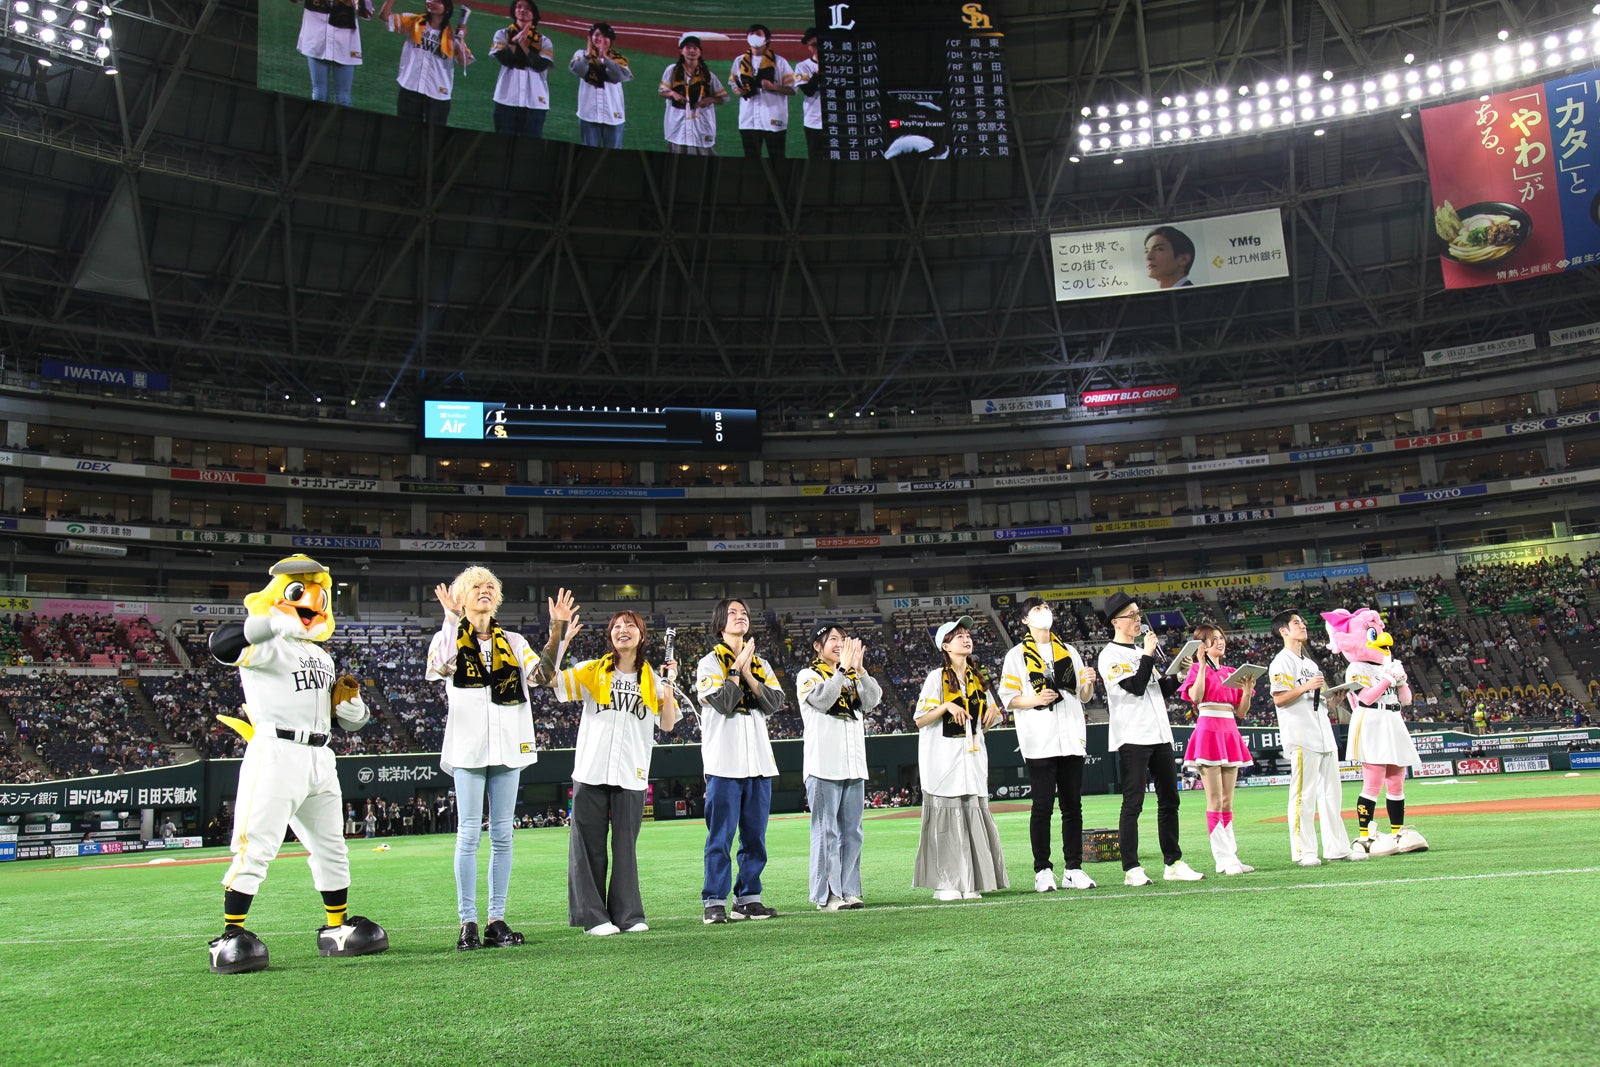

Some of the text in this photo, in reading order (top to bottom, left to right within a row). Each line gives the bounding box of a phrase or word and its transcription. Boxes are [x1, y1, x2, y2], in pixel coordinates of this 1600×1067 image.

[861, 41, 873, 49] 2B
[951, 40, 961, 48] CF
[862, 53, 873, 61] 1B
[952, 51, 963, 59] DH
[863, 64, 873, 73] LF
[952, 63, 963, 71] RF
[864, 78, 875, 86] DH
[954, 75, 964, 83] 1B
[864, 89, 875, 98] 3B
[955, 87, 965, 95] 3B
[898, 93, 934, 101] 2024.3.16
[865, 102, 876, 110] CF
[956, 99, 966, 107] LF
[866, 114, 877, 122] SS
[957, 111, 968, 119] SS
[900, 120, 945, 128] PayPay Dome
[1474, 104, 1505, 155] ある。
[867, 138, 879, 146] RF
[961, 136, 967, 144] C
[871, 150, 877, 159] P
[962, 148, 968, 156] P
[1229, 236, 1261, 248] YMfg
[1058, 241, 1125, 256] この世界で。
[1228, 250, 1281, 265] 北九州銀行
[1060, 260, 1114, 273] この街で。
[1062, 276, 1129, 291] このじぶん。
[64, 366, 126, 384] IWATAYA
[1083, 387, 1177, 404] ORIENT BLD. GROUP
[715, 412, 722, 421] B
[1557, 415, 1591, 427] SCSK
[440, 419, 466, 434] Air
[715, 422, 723, 431] S
[1512, 420, 1546, 434] SCSK
[1409, 433, 1459, 447] ピエトロ
[76, 461, 112, 473] IDEX
[200, 471, 240, 483] ROYAL
[1110, 467, 1155, 479] Sanikleen
[301, 478, 377, 491] ナガノインテリア
[838, 484, 876, 495] ロキテクノ
[544, 488, 564, 496] CTC
[1424, 488, 1461, 500] TOTO
[88, 525, 132, 537] 東京建物
[304, 537, 381, 549] ネスト NESTPIA
[421, 540, 477, 551] インフォセンス
[816, 537, 879, 547] トミナガコーポレーション
[1181, 576, 1252, 590] CHIKYUJIN
[911, 596, 954, 608] 第一商事
[466, 661, 483, 678] 21
[1507, 761, 1547, 771] 作州商事
[378, 766, 438, 782] 東洋ホイスト
[1021, 784, 1032, 797] ア
[69, 788, 129, 805] ヨドバシカメラ
[138, 787, 197, 806] 日田天領水
